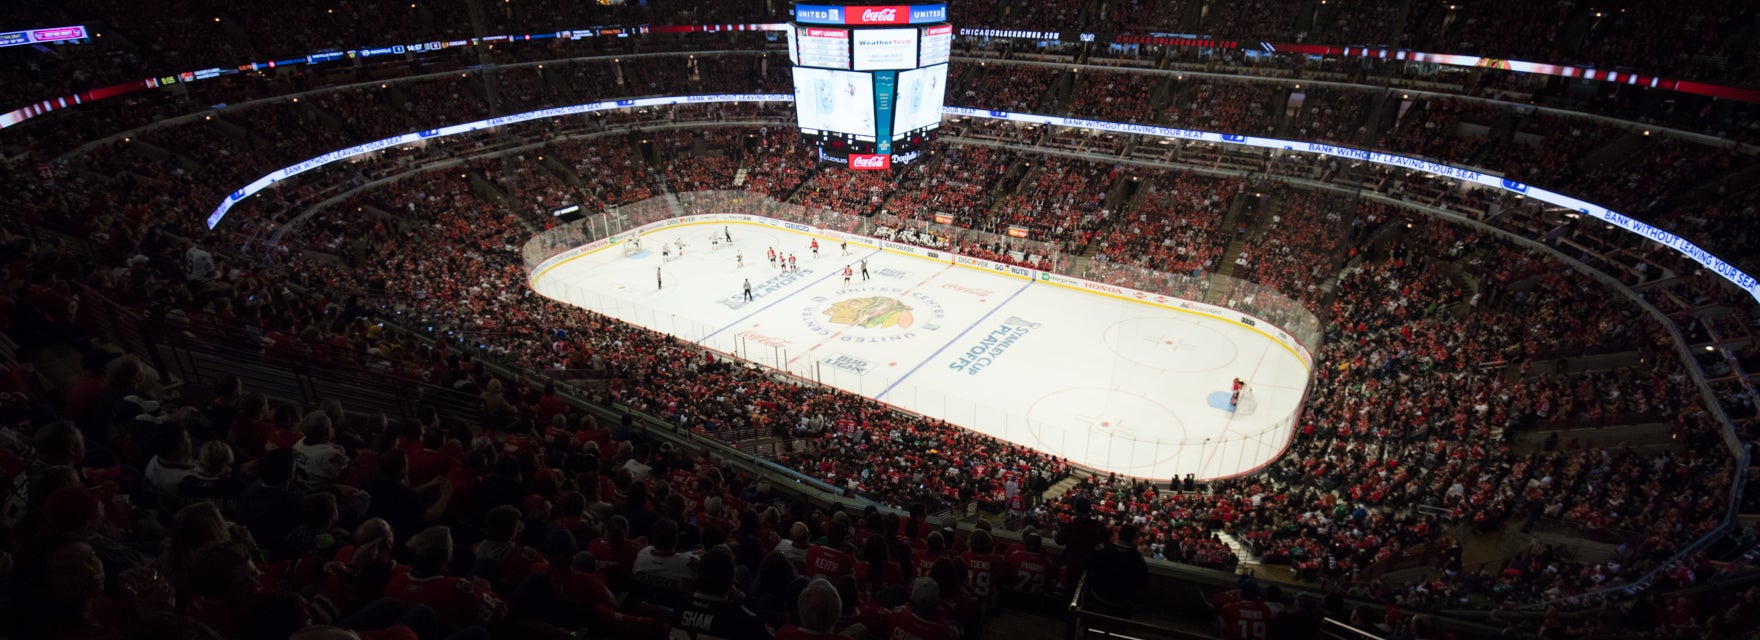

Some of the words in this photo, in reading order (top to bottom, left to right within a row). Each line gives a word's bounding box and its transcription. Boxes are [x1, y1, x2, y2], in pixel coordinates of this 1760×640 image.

[798, 10, 827, 19] UNITED
[914, 10, 941, 18] UNITED
[960, 27, 1060, 40] CHICAGOBLACKHAWKS.COM
[1116, 35, 1237, 49] CHICAGOBLACKHAWKS.COM
[486, 118, 505, 126] BANK
[506, 112, 536, 123] WITHOUT
[537, 107, 567, 118] LEAVING
[567, 104, 585, 113] YOUR
[587, 102, 603, 110] SEAT
[1062, 118, 1084, 127] BANK
[1085, 119, 1121, 131] WITHOUT
[1122, 124, 1158, 135] LEAVING
[1158, 127, 1182, 137] YOUR
[1183, 130, 1205, 139] SEAT
[283, 163, 303, 177] BANK
[303, 154, 333, 170] WITHOUT
[333, 146, 365, 160] LEAVING
[366, 139, 385, 152] YOUR
[385, 136, 402, 147] SEAT
[1308, 143, 1335, 155] BANK
[1337, 147, 1382, 162] WITHOUT
[1383, 154, 1425, 170] LEAVING
[1427, 162, 1454, 176] YOUR
[1455, 168, 1481, 182] SEAT
[785, 222, 810, 232] GEICO
[580, 240, 608, 252] HONDA
[885, 242, 914, 252] GATORADE
[1604, 210, 1631, 228] BANK
[1632, 219, 1680, 246] WITHOUT
[1680, 239, 1713, 266] LEAVING
[1714, 260, 1737, 280] YOUR
[1736, 274, 1760, 292] SEAT
[836, 286, 902, 295] UNITED
[1084, 282, 1123, 294] HONDA
[802, 306, 830, 336] CENTER
[840, 332, 916, 343] UNITED
[988, 326, 1029, 359] STANLEY
[949, 324, 1013, 372] PLAYOFFS
[836, 354, 868, 368] BUD
[968, 356, 992, 375] CUP
[814, 557, 839, 573] KEITH
[967, 569, 992, 596] 19
[1017, 569, 1043, 593] 72
[681, 609, 715, 632] SHAW
[1238, 620, 1266, 640] 19
